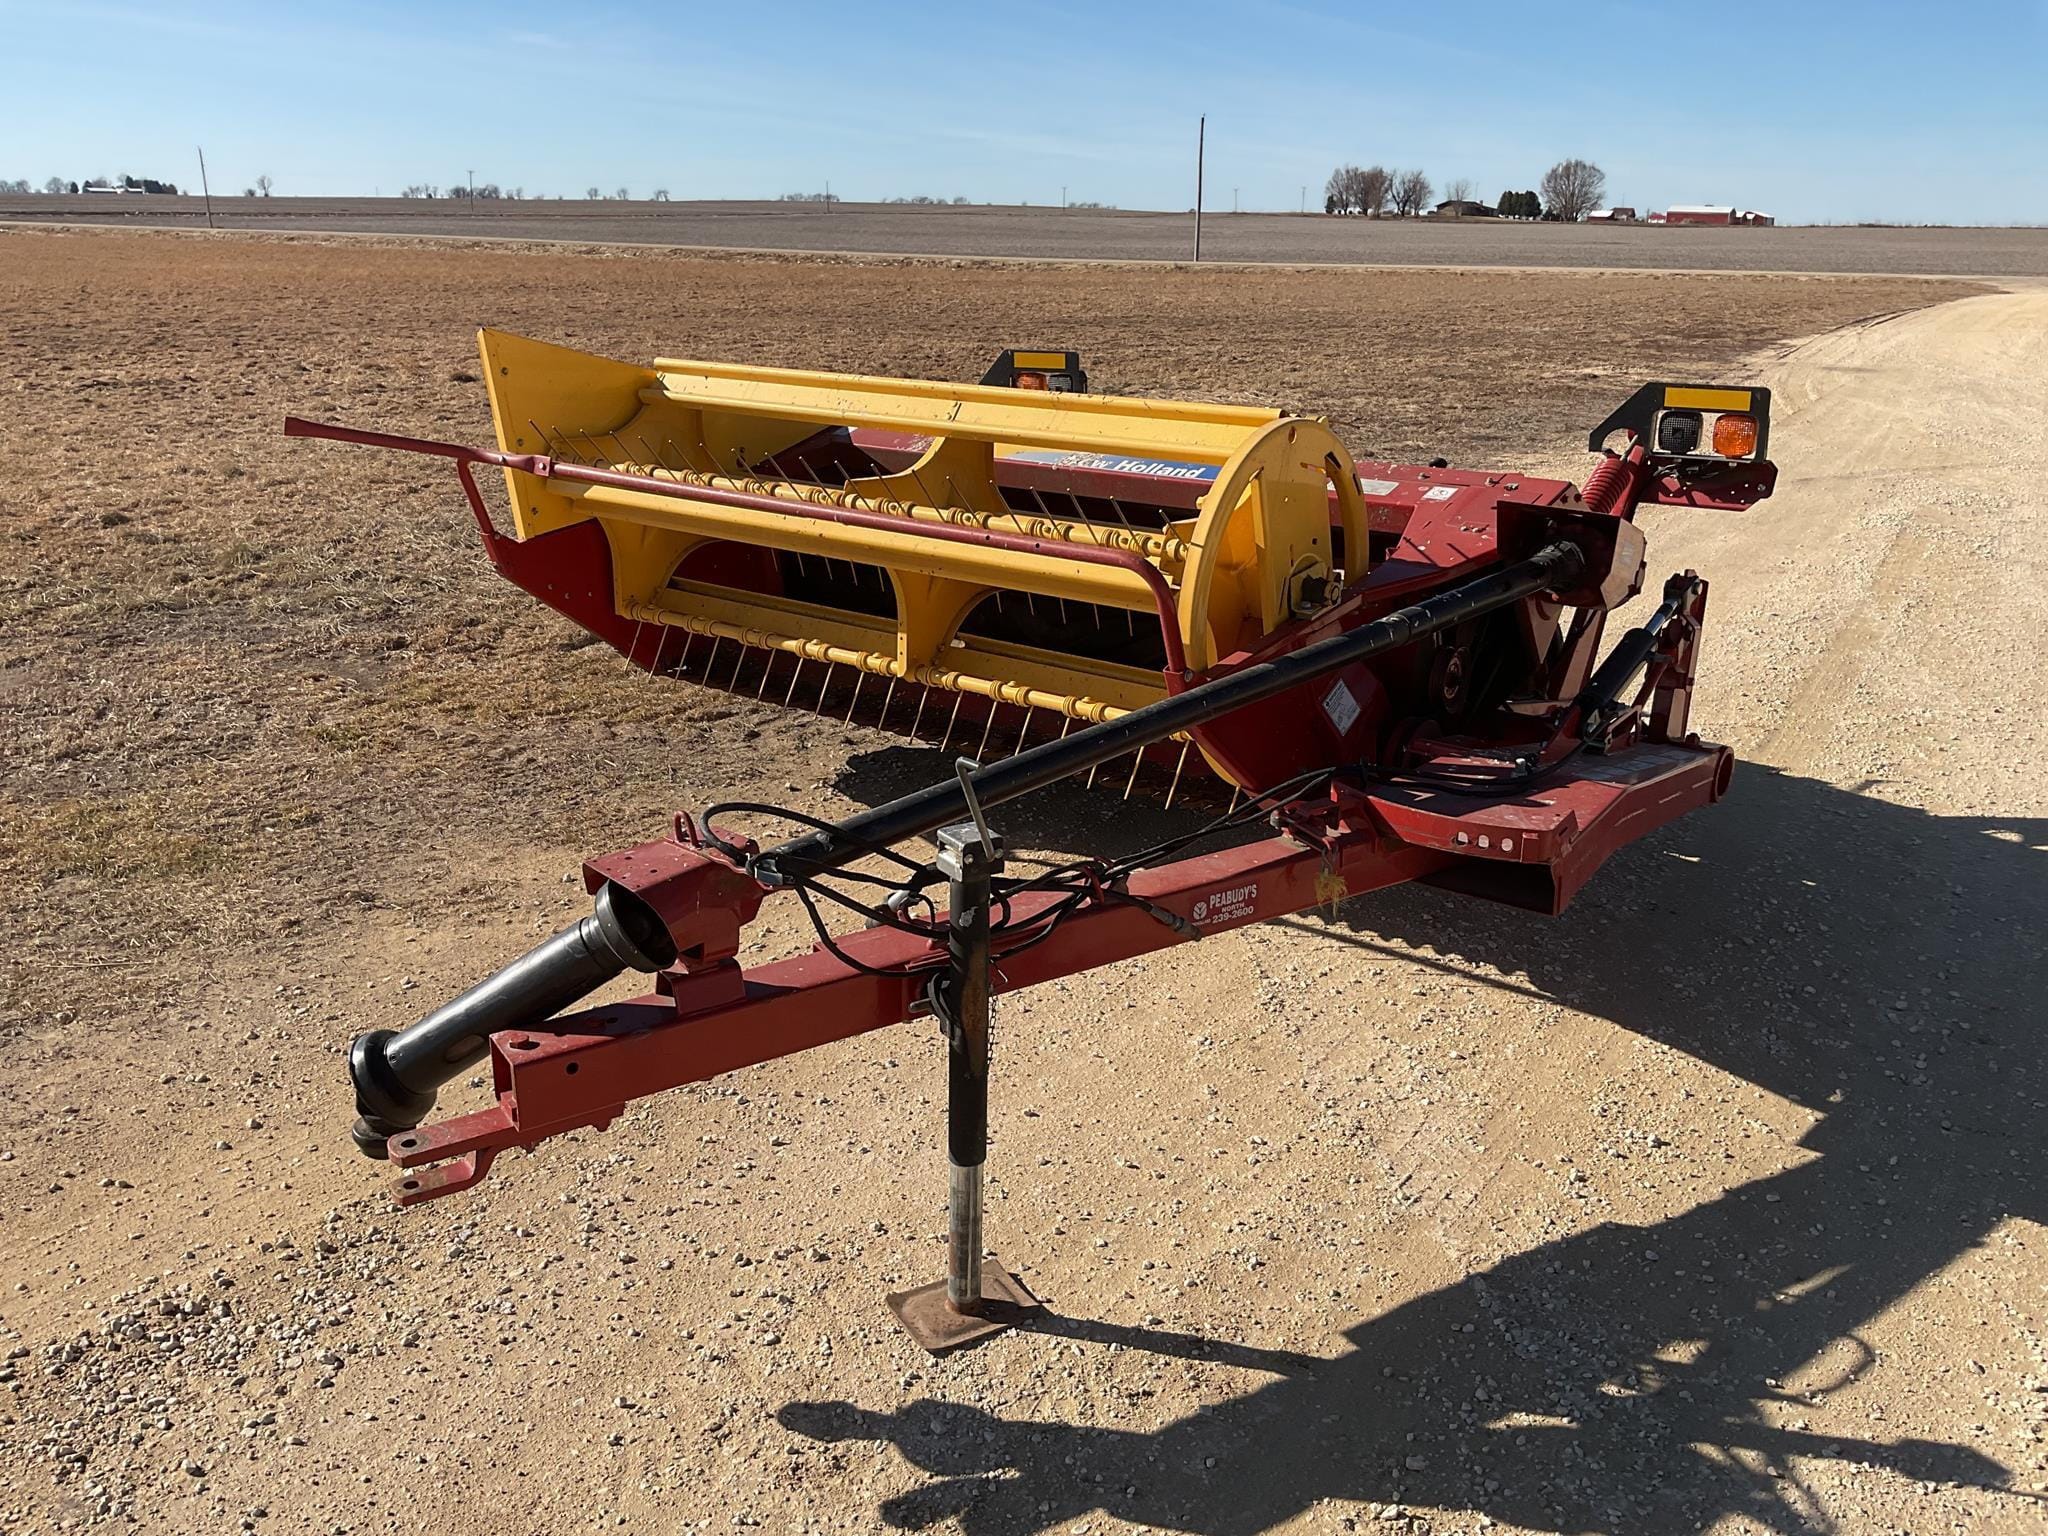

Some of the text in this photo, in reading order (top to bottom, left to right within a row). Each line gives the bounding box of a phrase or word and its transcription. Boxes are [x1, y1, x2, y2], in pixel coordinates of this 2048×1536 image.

[1114, 460, 1206, 478] Holland
[1210, 884, 1257, 909] PEABUDY'S
[1212, 905, 1254, 924] 239-2600
[1221, 902, 1245, 913] NORTH
